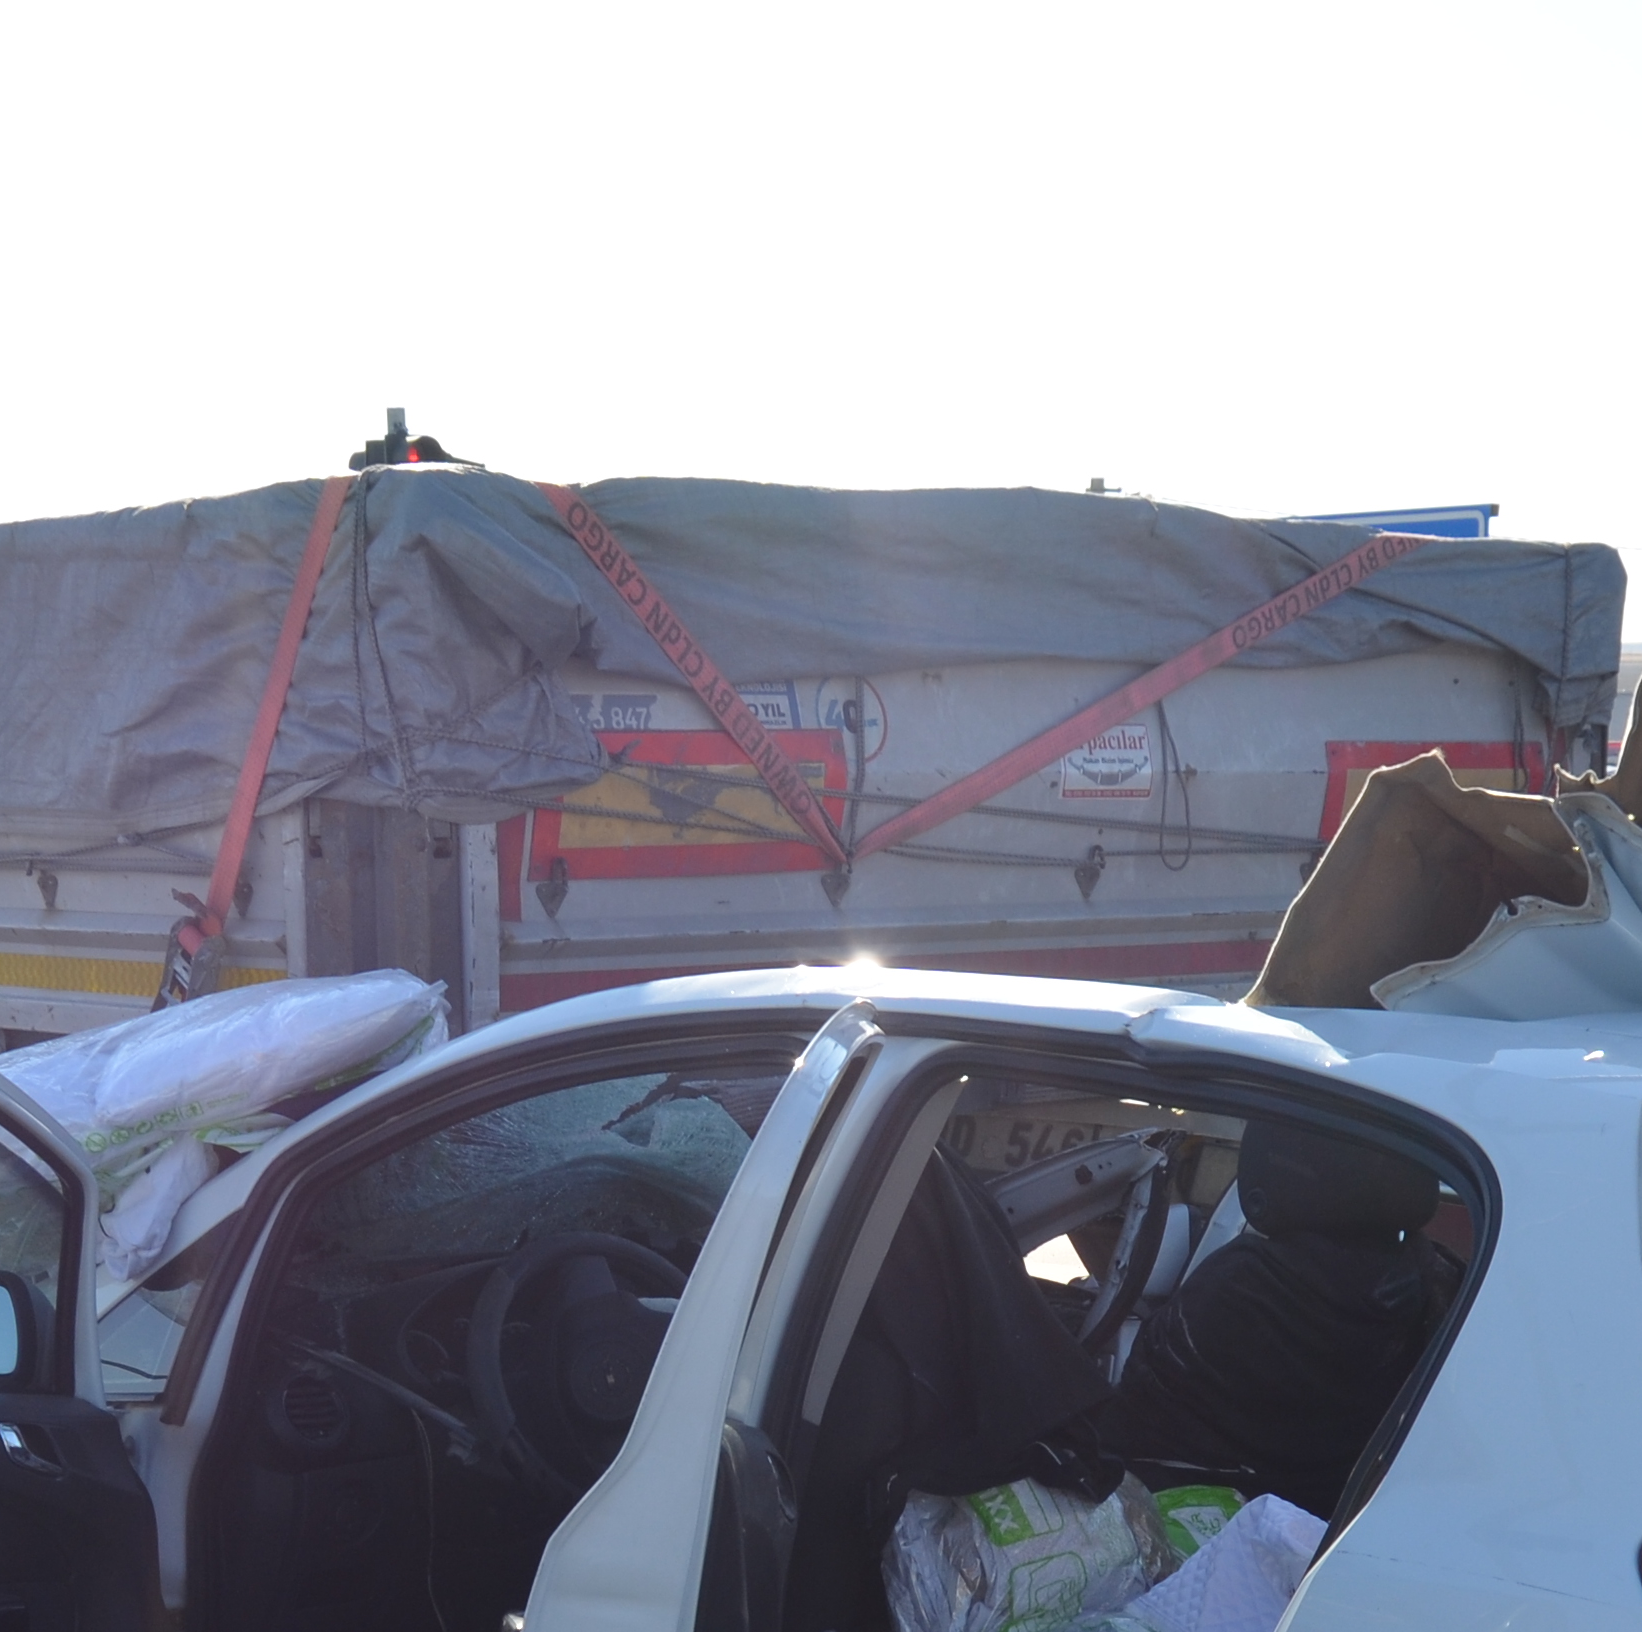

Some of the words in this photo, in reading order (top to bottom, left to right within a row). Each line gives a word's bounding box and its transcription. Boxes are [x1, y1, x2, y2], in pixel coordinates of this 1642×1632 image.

[566, 501, 647, 606] CARGO
[1357, 547, 1380, 579] BY
[1232, 593, 1301, 650] CARGO
[702, 675, 735, 718] BY
[760, 703, 786, 718] YIL
[611, 706, 648, 730] 847
[1083, 729, 1146, 756] pacılar
[732, 713, 811, 815] OWNED
